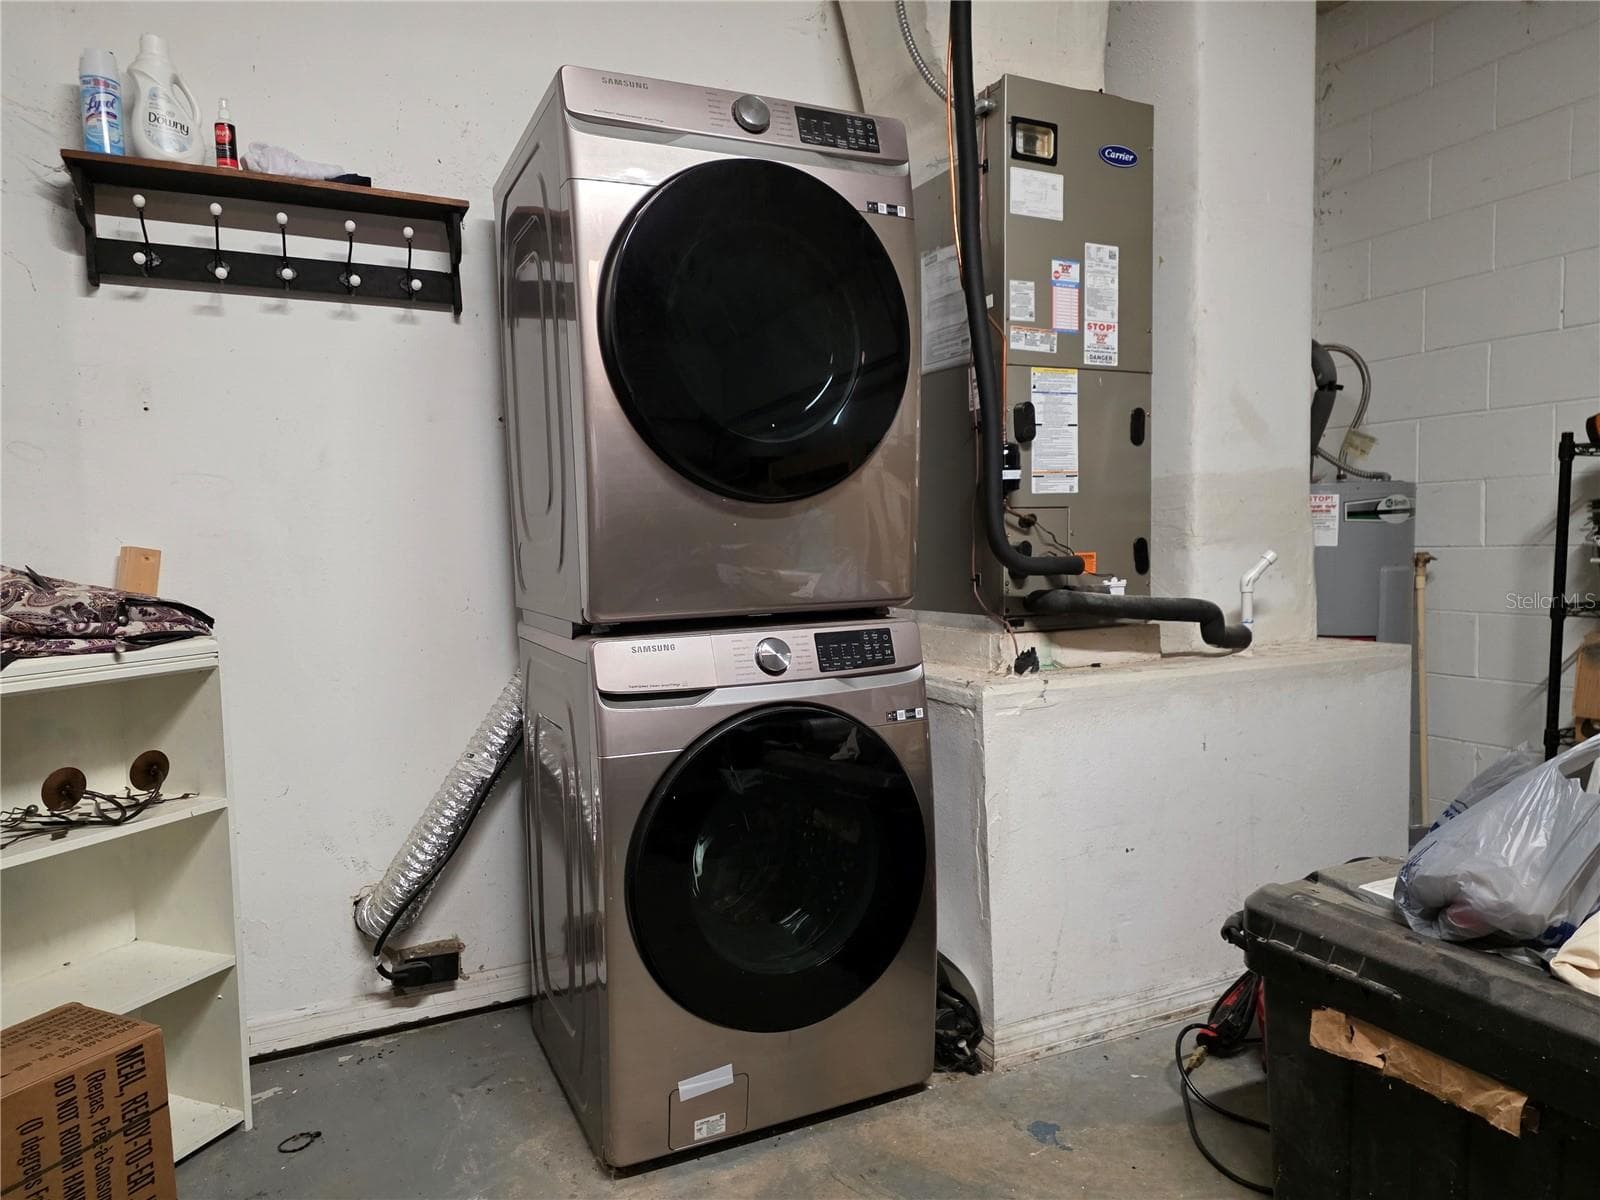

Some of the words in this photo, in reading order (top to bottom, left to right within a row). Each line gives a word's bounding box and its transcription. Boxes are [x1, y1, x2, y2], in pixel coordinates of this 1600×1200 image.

[601, 76, 649, 90] SAMSUNG
[86, 95, 116, 113] Lyol
[148, 112, 189, 136] Downy
[1105, 148, 1134, 161] Carrier
[1087, 322, 1116, 332] STOP!
[631, 643, 676, 654] SAMSUNG
[115, 1043, 147, 1098] MEAL,
[54, 1074, 77, 1098] DO
[83, 1068, 106, 1119] (Repas,
[56, 1096, 80, 1126] NOT
[16, 1136, 45, 1190] degres
[91, 1115, 114, 1200] Prê-à-Conso
[62, 1170, 86, 1200] HAN
